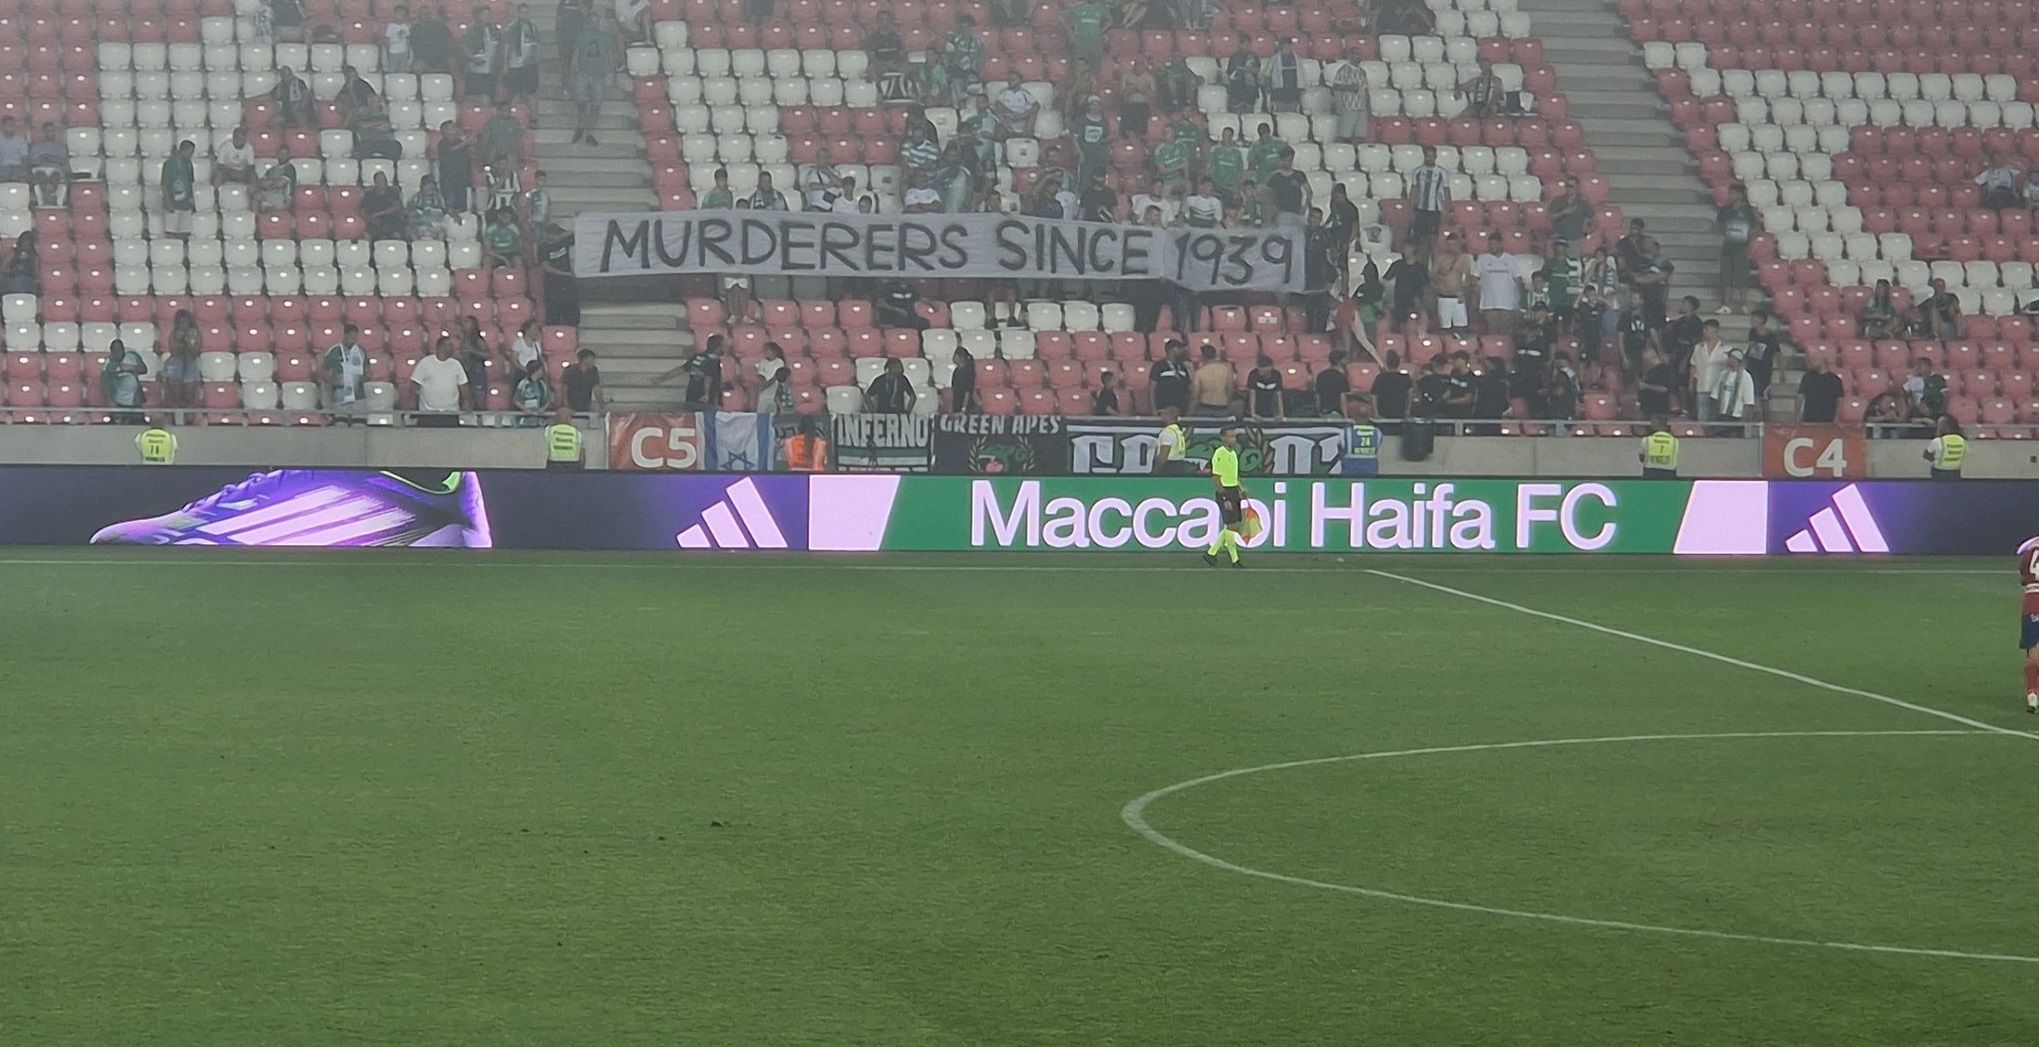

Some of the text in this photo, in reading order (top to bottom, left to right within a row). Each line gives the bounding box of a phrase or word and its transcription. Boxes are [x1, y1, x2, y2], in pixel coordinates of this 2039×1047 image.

[600, 218, 1293, 287] MURDERERS SINCE 1939
[837, 413, 930, 447] INFERNO
[939, 414, 1062, 434] GREEN APES
[630, 427, 697, 469] C5
[1783, 437, 1847, 477] C4
[1310, 482, 1496, 550] Haifa
[1515, 482, 1618, 550] FC
